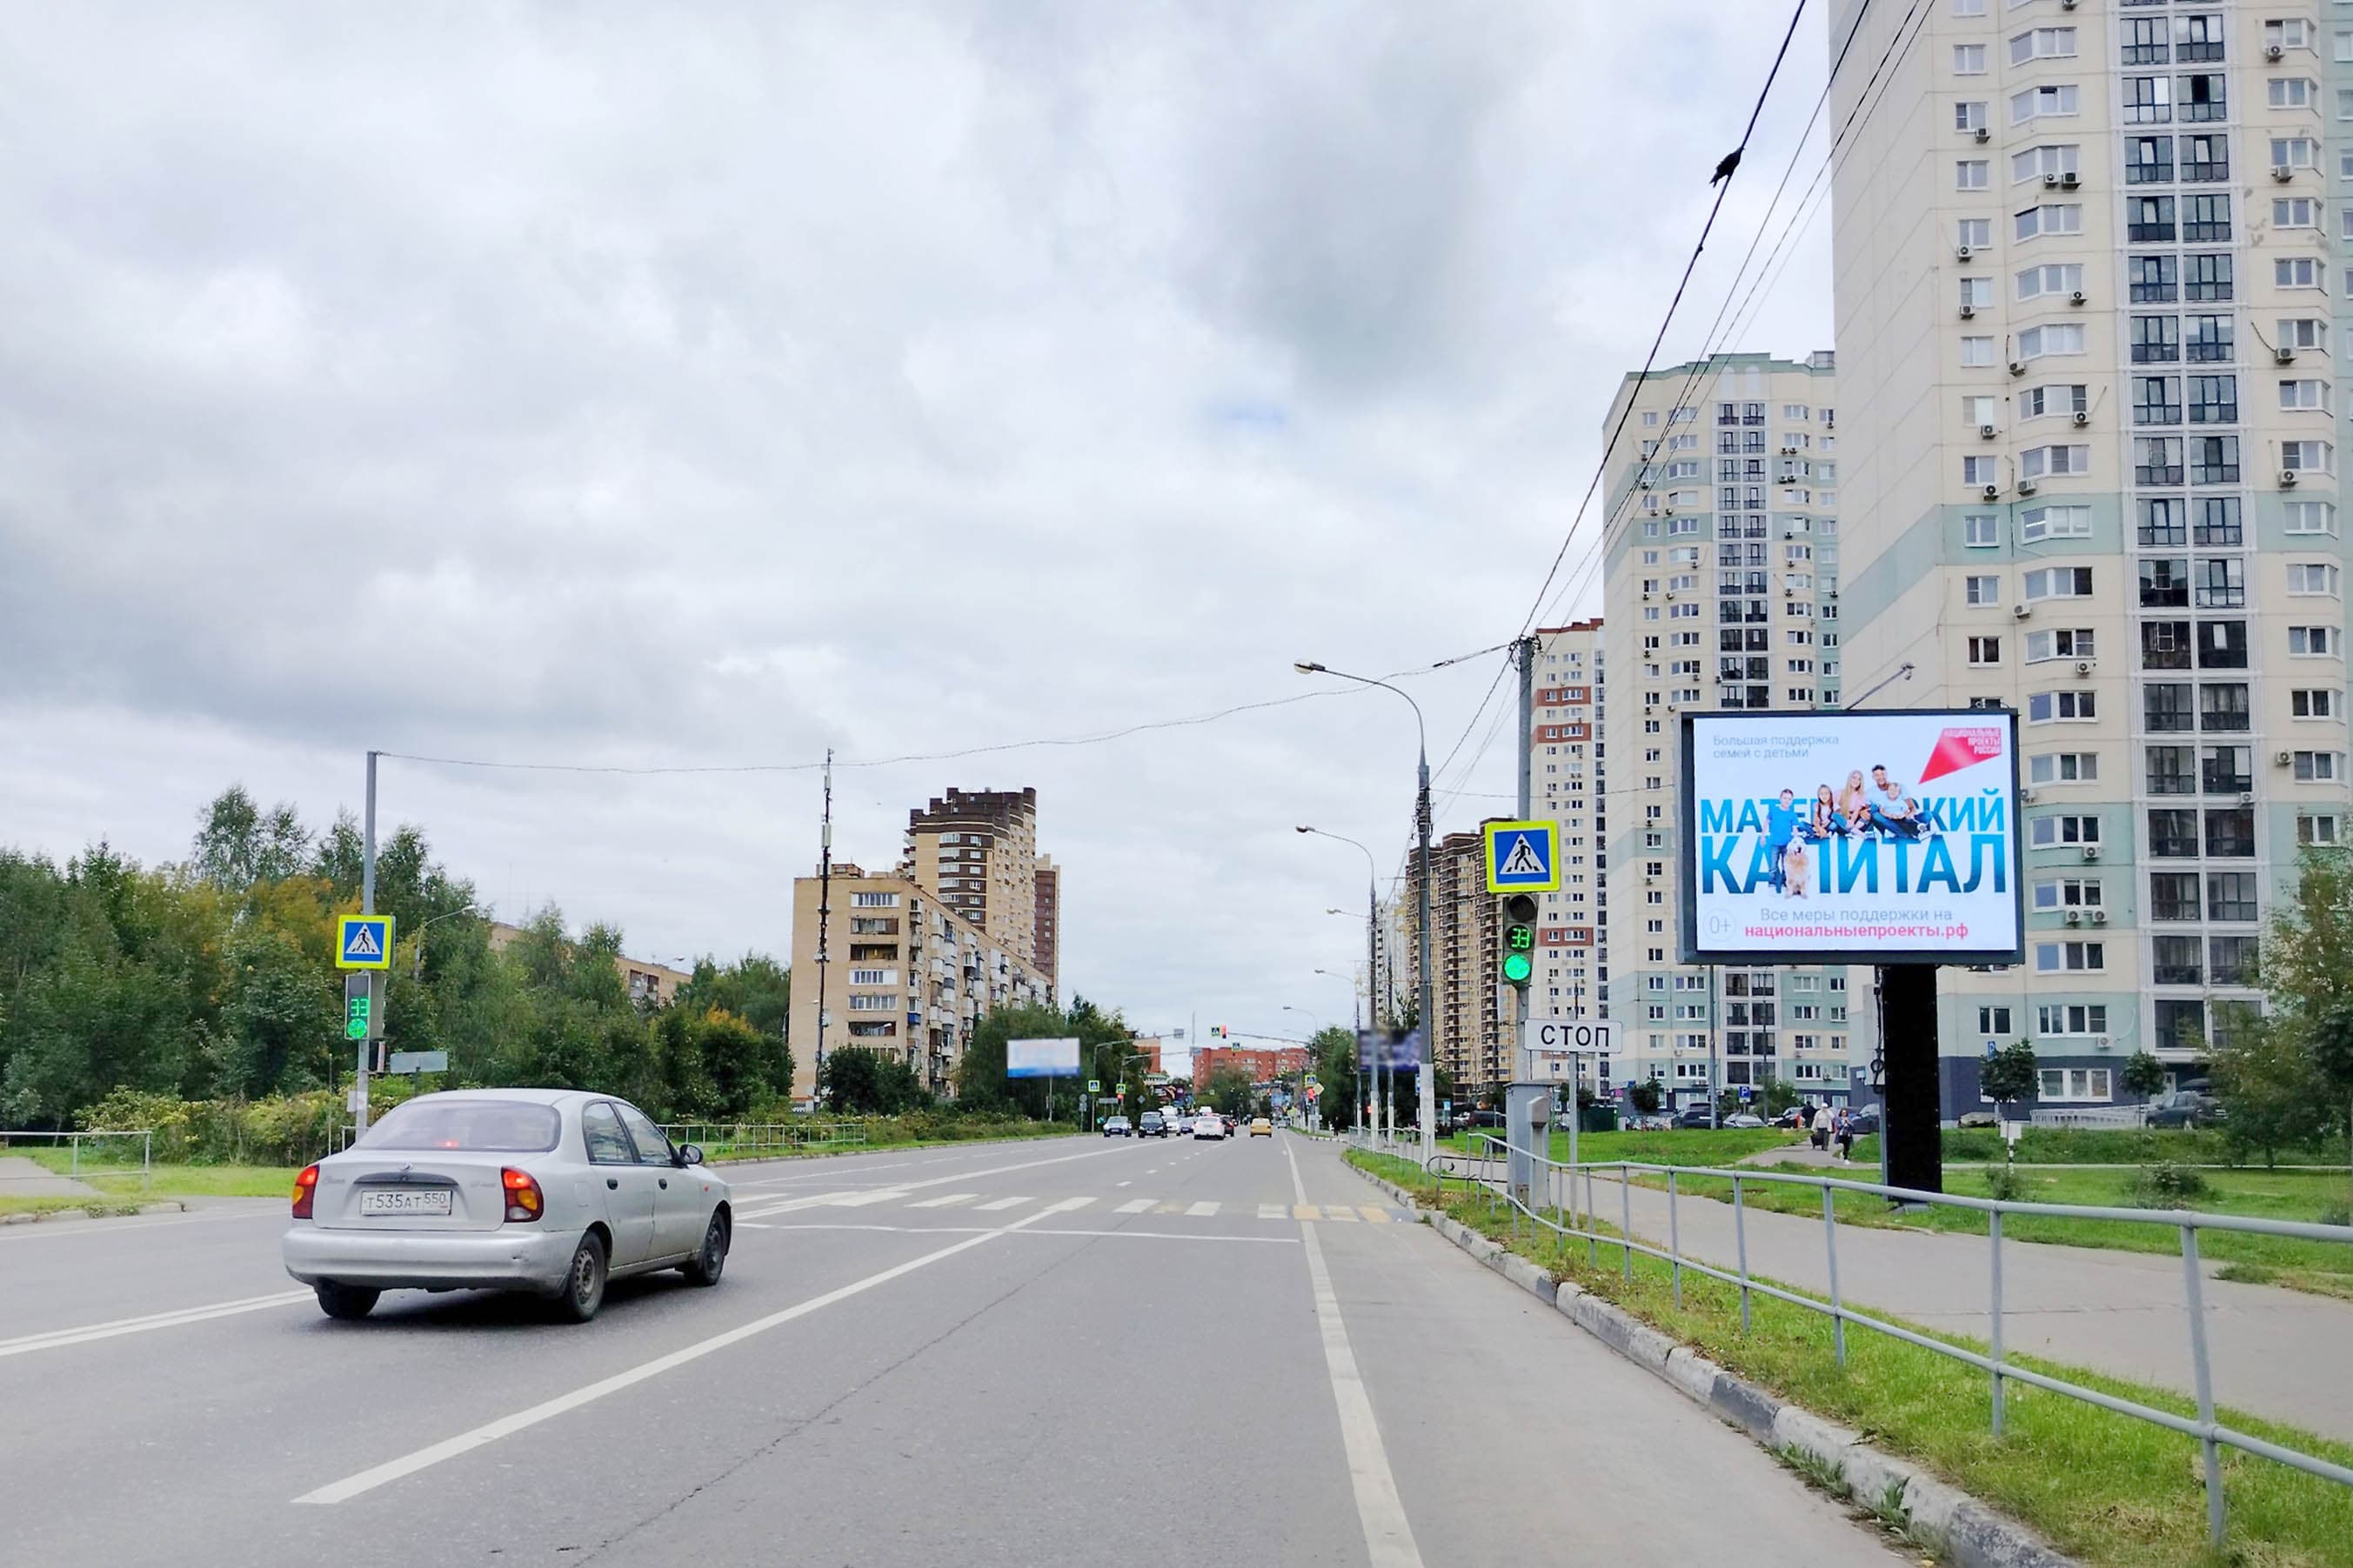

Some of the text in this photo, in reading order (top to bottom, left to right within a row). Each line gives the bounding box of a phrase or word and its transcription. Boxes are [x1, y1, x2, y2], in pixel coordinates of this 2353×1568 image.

[1713, 735, 1840, 748] Большая поддержка
[1713, 748, 1809, 759] семей с детьми
[1701, 788, 2004, 832] МАТЕКИЙ
[1701, 834, 2006, 895] КАПИТАЛ
[1709, 915, 1732, 934] 0+
[1760, 908, 1953, 924] Все меры поддержки на
[1511, 928, 1530, 949] 33
[1744, 923, 1969, 940] национальныепроекты.рф
[351, 998, 369, 1016] 33
[1541, 1024, 1609, 1047] СТОП
[424, 1192, 446, 1204] 550
